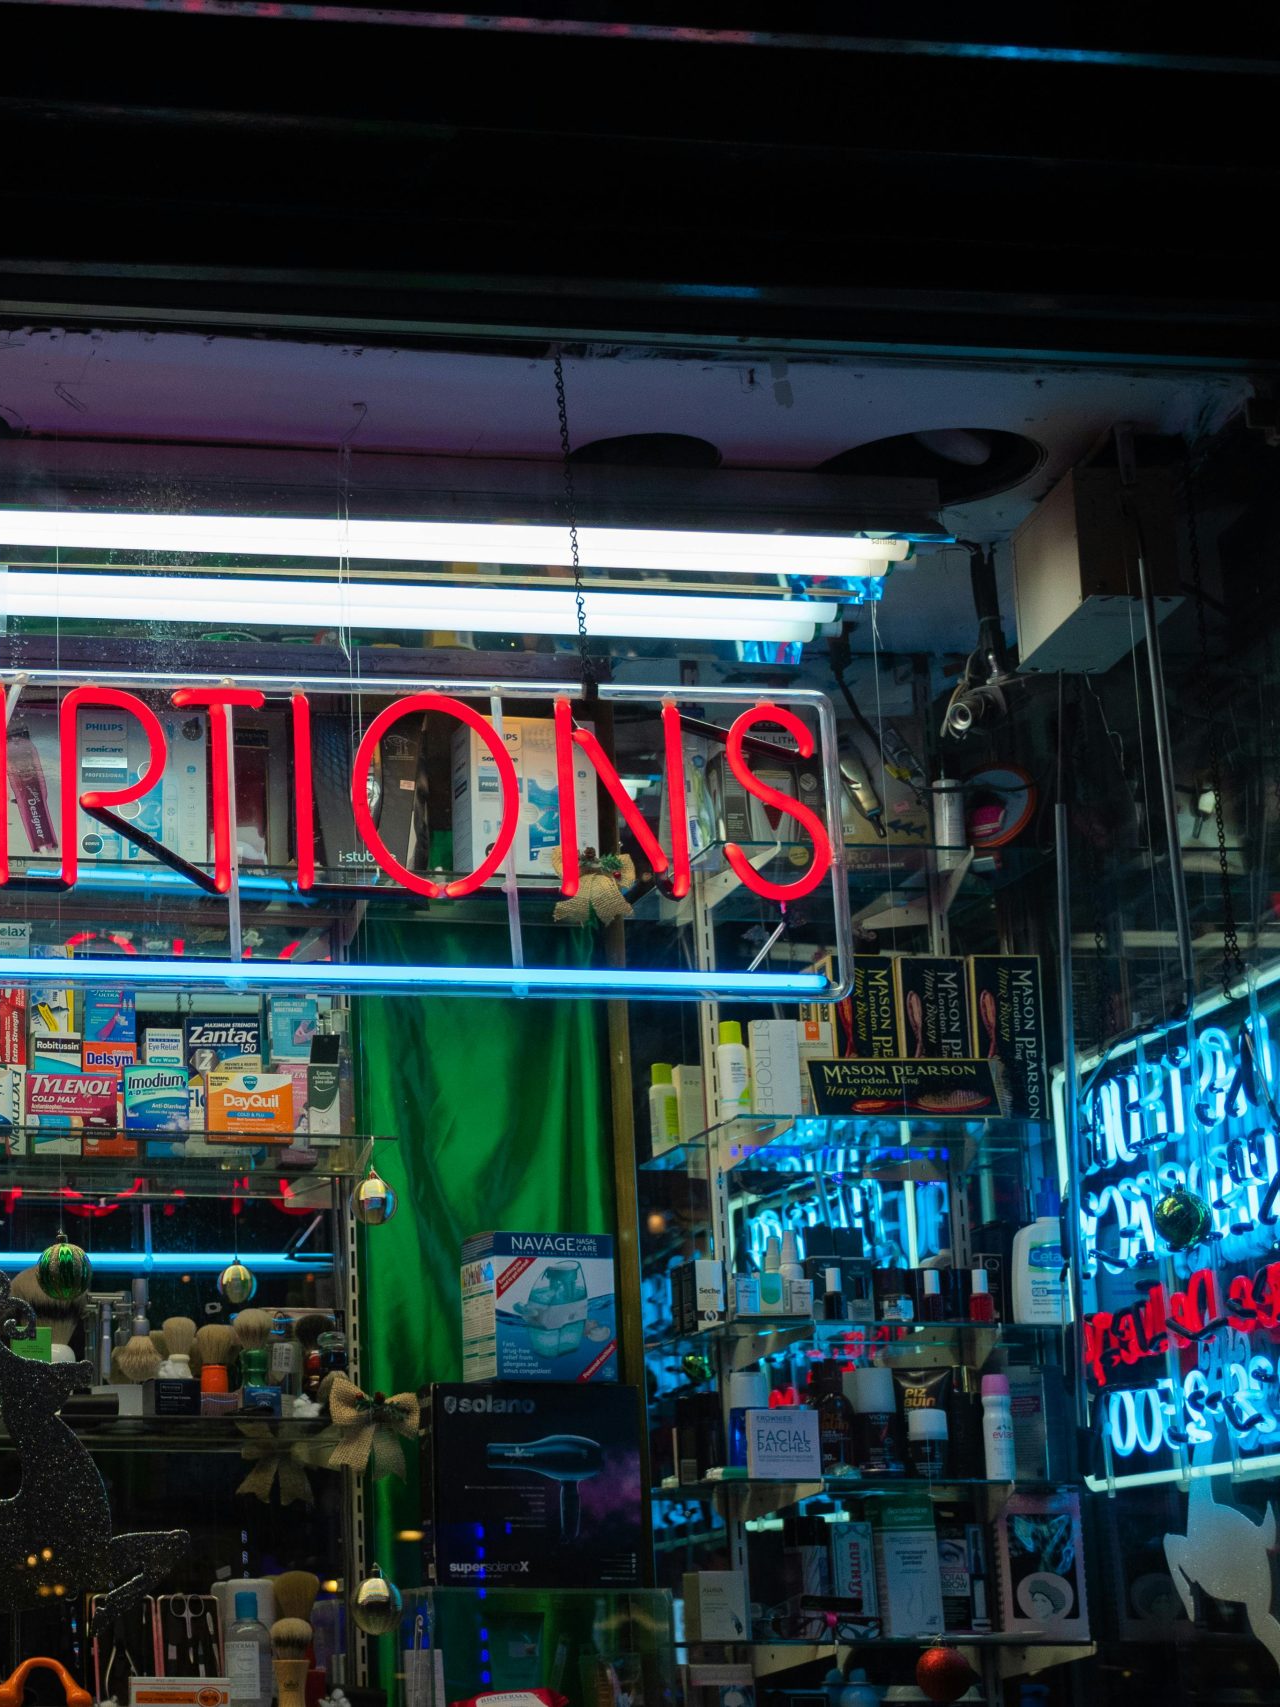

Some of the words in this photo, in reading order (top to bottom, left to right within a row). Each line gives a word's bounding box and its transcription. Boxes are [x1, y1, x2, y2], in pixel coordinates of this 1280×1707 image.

[85, 723, 123, 732] PHILIPS
[85, 745, 124, 753] sonicare
[28, 797, 46, 839] Designer
[338, 851, 397, 863] i-stube
[868, 969, 893, 1030] MASON
[937, 970, 961, 1033] MASON
[1011, 969, 1036, 1031] MASON
[11, 1011, 19, 1042] Strength
[854, 1000, 868, 1041] BRUSH
[924, 1001, 938, 1044] BRUSH
[998, 1000, 1012, 1042] BRUSH
[189, 1026, 258, 1043] Zantac
[37, 1040, 79, 1050] Robitussin
[148, 1043, 160, 1051] Eye
[161, 1042, 180, 1050] Relief
[240, 1044, 256, 1053] 150
[86, 1052, 134, 1067] Delsym
[128, 1074, 184, 1089] Imodium
[822, 1065, 886, 1083] MASON
[892, 1064, 977, 1084] PEARSON
[1015, 1035, 1041, 1119] PEARSON
[31, 1074, 112, 1095] TYLENOL
[825, 1085, 858, 1097] HAIR
[861, 1084, 903, 1097] BRUSH
[32, 1095, 53, 1103] COLD
[223, 1094, 280, 1110] DayQuil
[511, 1234, 576, 1252] NAVÄGE
[699, 1286, 721, 1295] Seche
[503, 1348, 531, 1356] drug-free
[503, 1361, 527, 1369] allergies
[905, 1388, 926, 1398] PIZ
[458, 1395, 535, 1414] solano
[904, 1396, 937, 1407] BUIN
[757, 1429, 811, 1443] FACIAL
[757, 1442, 812, 1453] PATCHES
